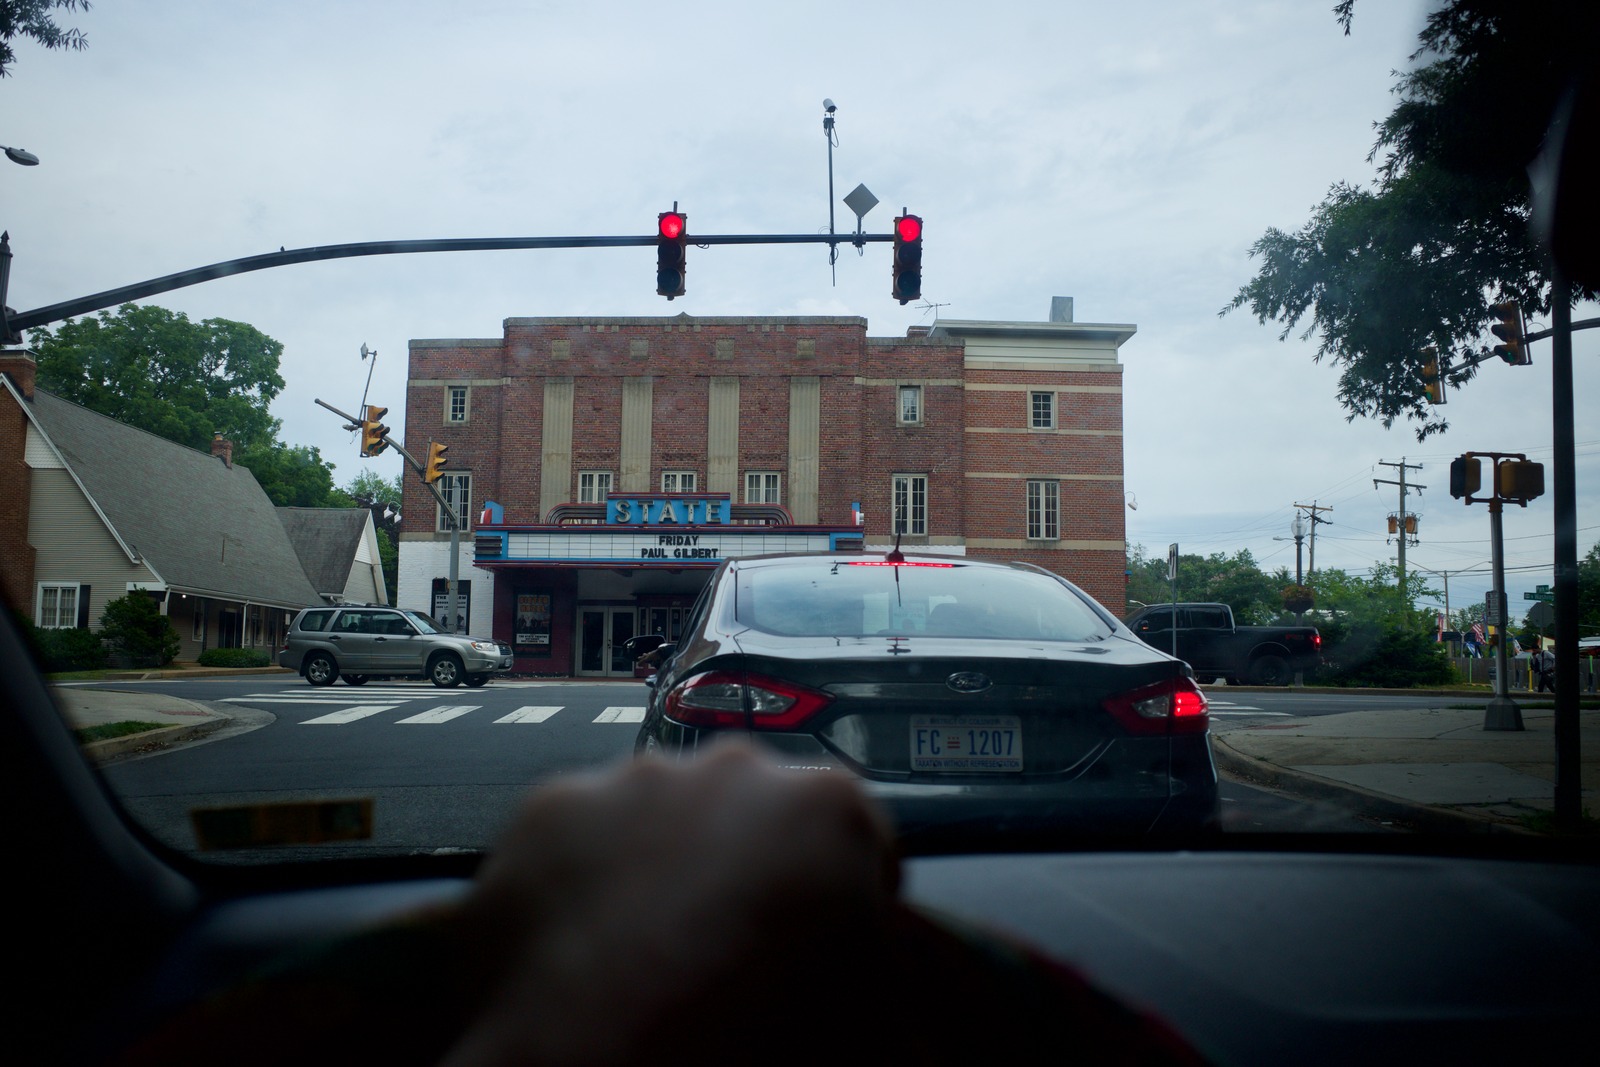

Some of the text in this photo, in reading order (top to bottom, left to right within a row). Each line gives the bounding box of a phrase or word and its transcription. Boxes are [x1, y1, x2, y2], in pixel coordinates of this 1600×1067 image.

[615, 500, 722, 523] STATE
[659, 535, 699, 546] FRIDAY
[641, 548, 718, 558] PAUL GILBERT
[917, 729, 1014, 756] FC 1207
[943, 760, 969, 768] WITHOUT
